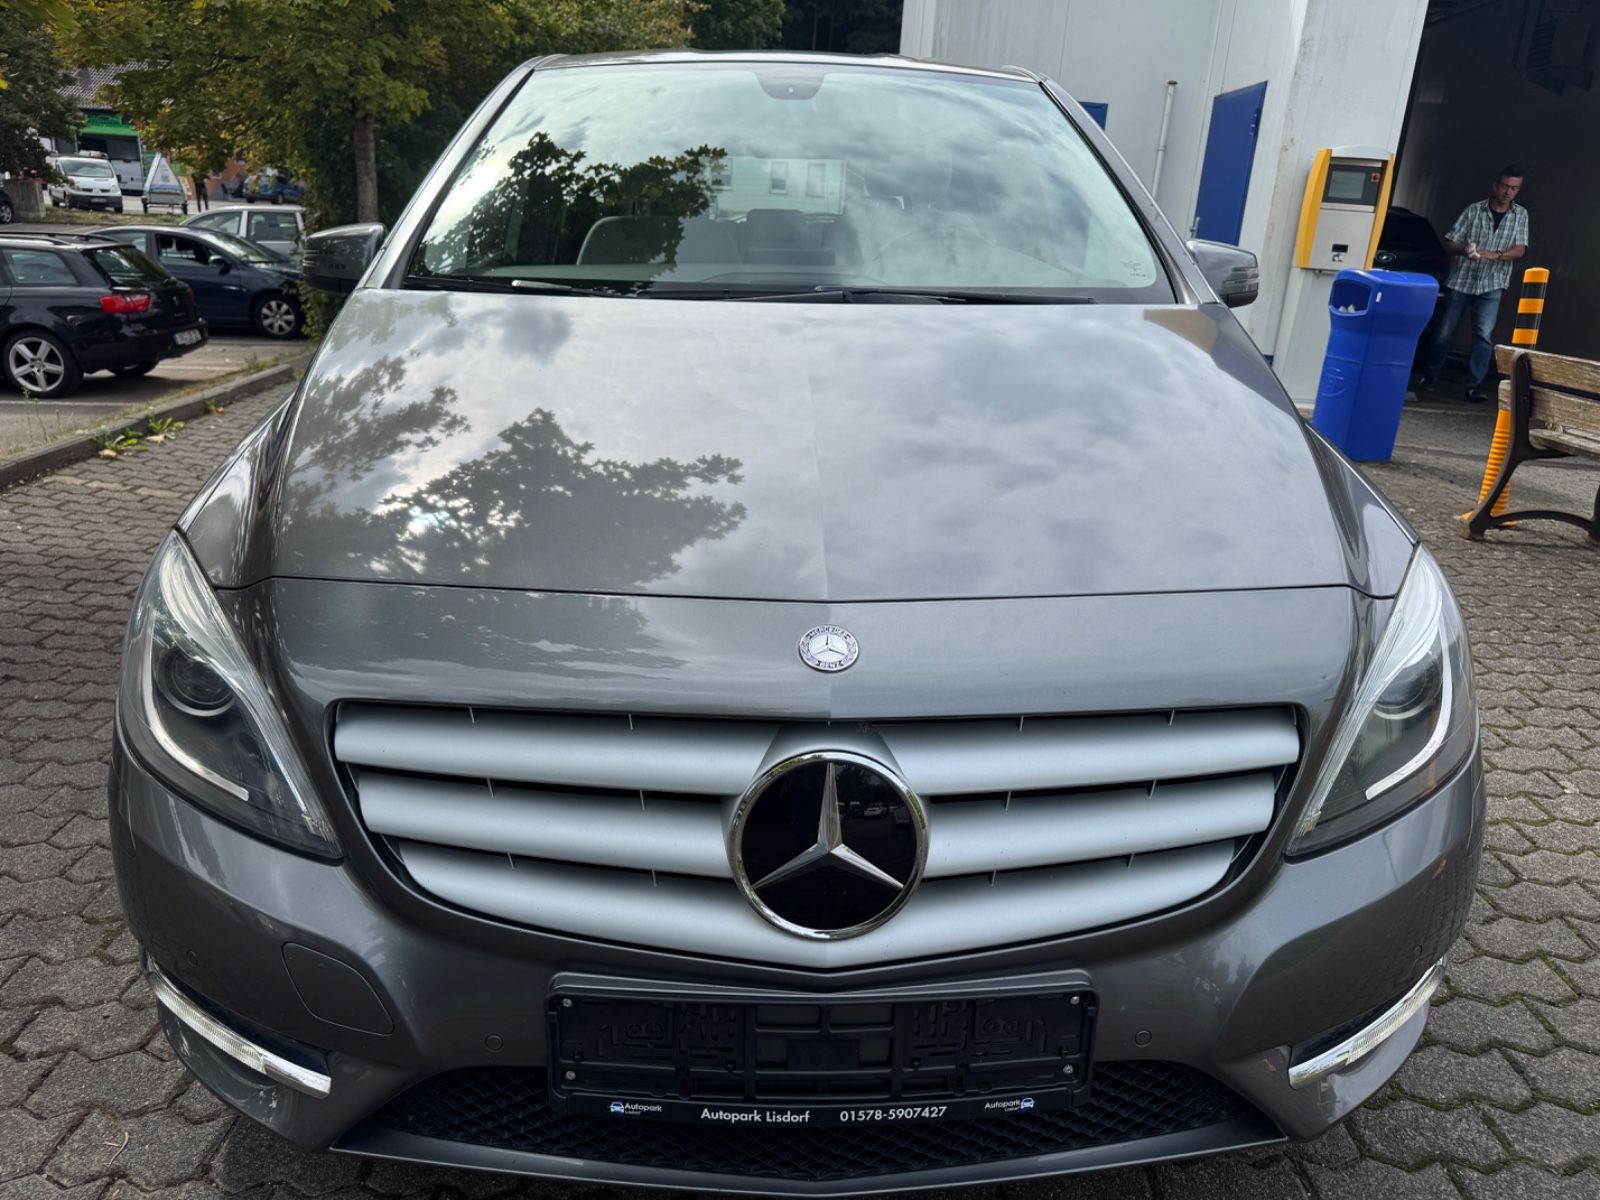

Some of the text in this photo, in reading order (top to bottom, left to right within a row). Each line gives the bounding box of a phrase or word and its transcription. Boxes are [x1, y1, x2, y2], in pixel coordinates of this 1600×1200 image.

[625, 1102, 662, 1112] Autopark
[984, 1099, 1021, 1109] Autopark
[700, 1106, 947, 1124] Autopark Lisdorf 01578-5907427
